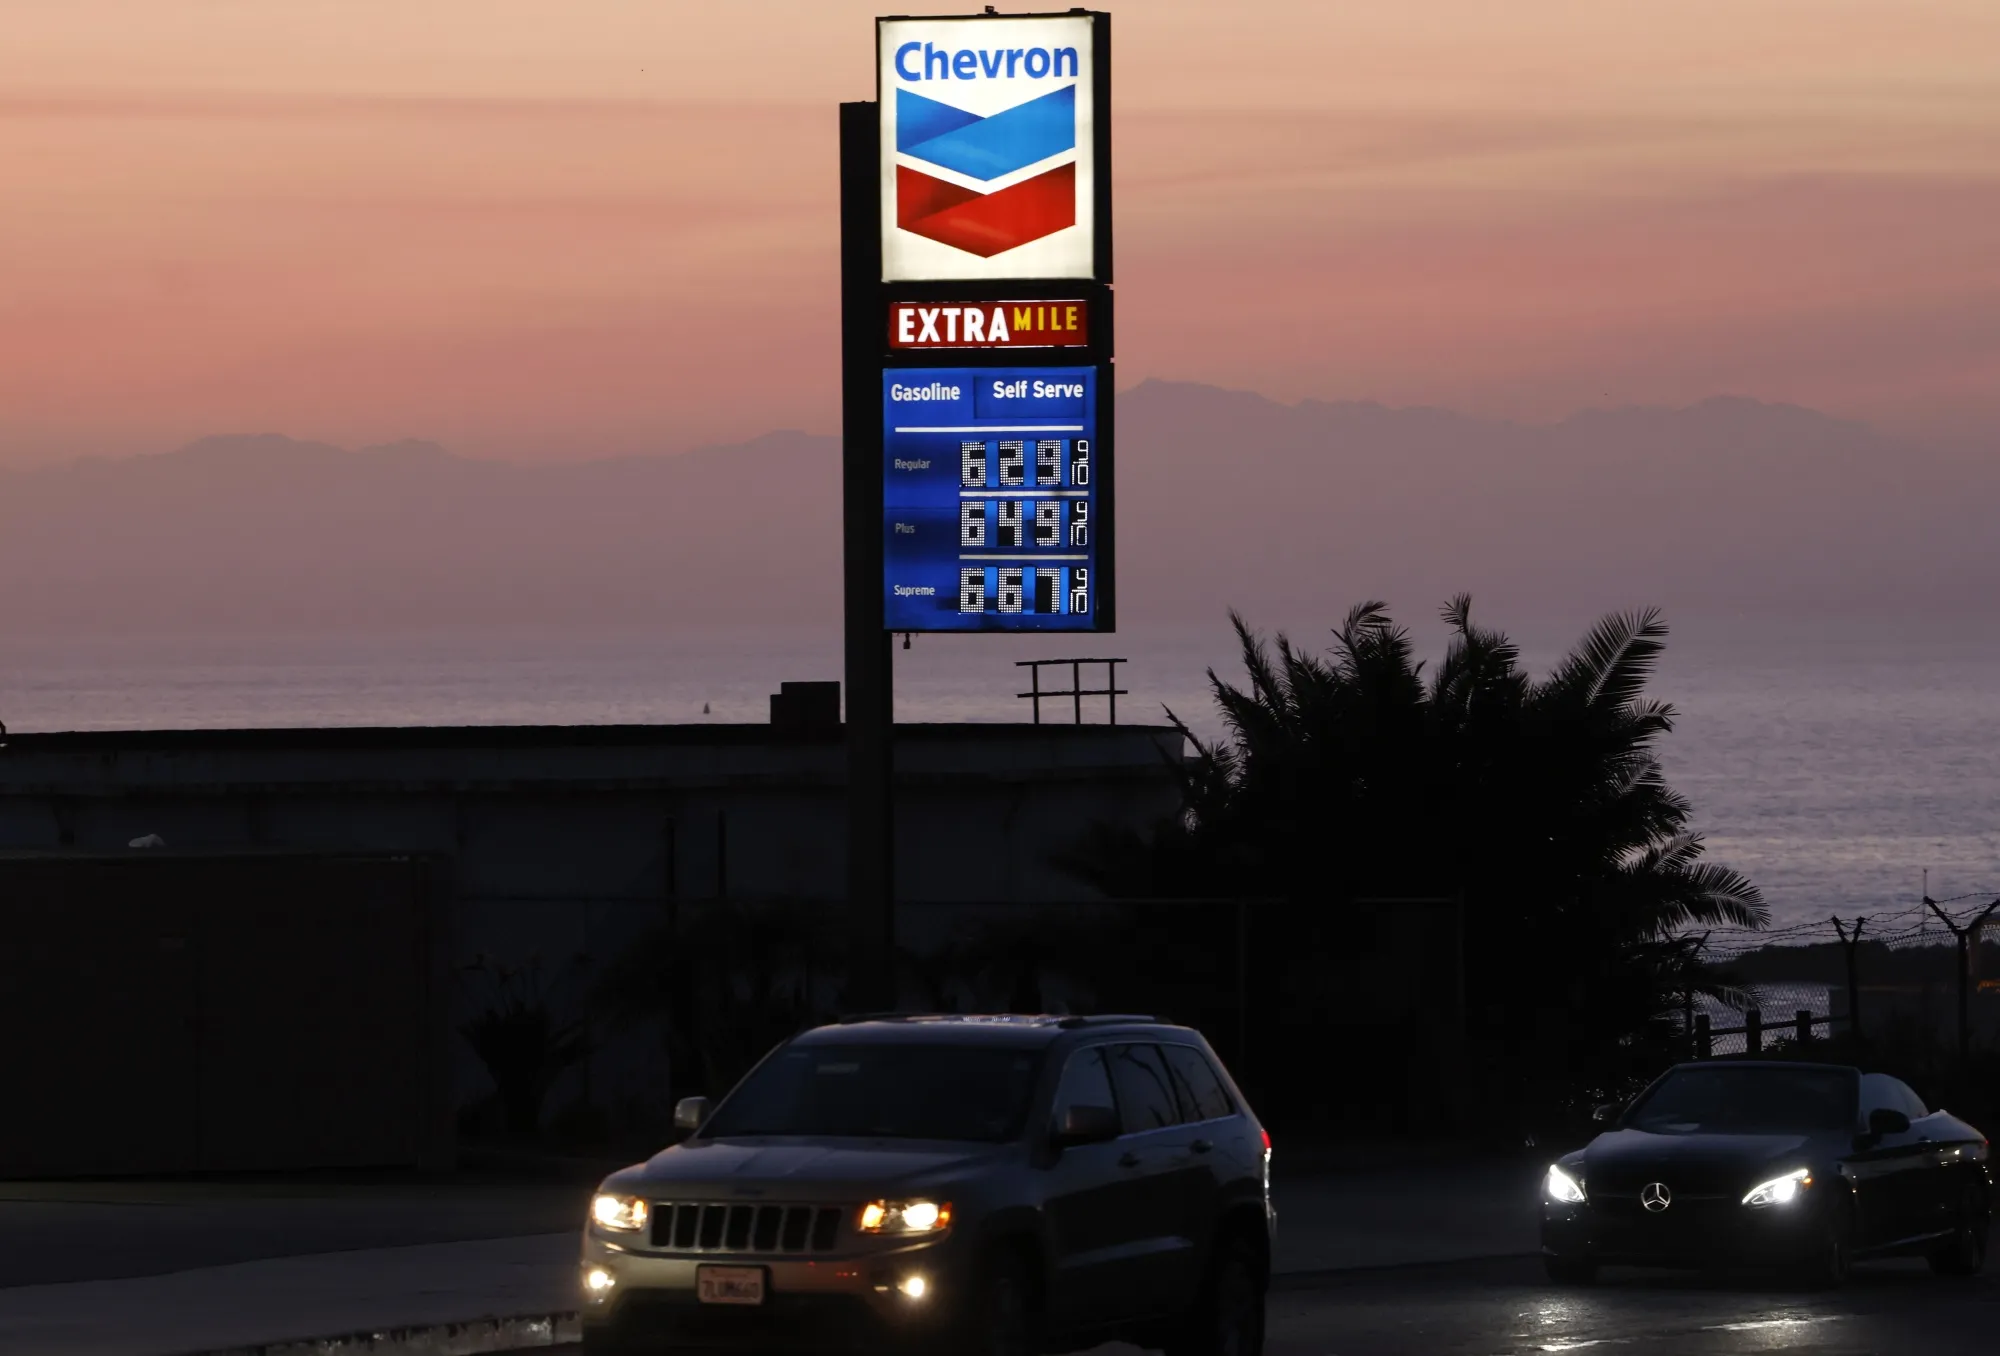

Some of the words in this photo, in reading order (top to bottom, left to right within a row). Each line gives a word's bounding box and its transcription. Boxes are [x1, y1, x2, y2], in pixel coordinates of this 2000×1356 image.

[895, 42, 1078, 81] Chevron
[891, 383, 960, 401] Gasoline
[993, 380, 1028, 398] Self
[1033, 381, 1084, 398] Serve
[895, 459, 931, 471] Regular
[961, 440, 1061, 486] 629
[895, 522, 915, 534] Plus
[961, 501, 1061, 546] 649
[894, 585, 936, 597] Supreme
[961, 568, 1060, 613] 667
